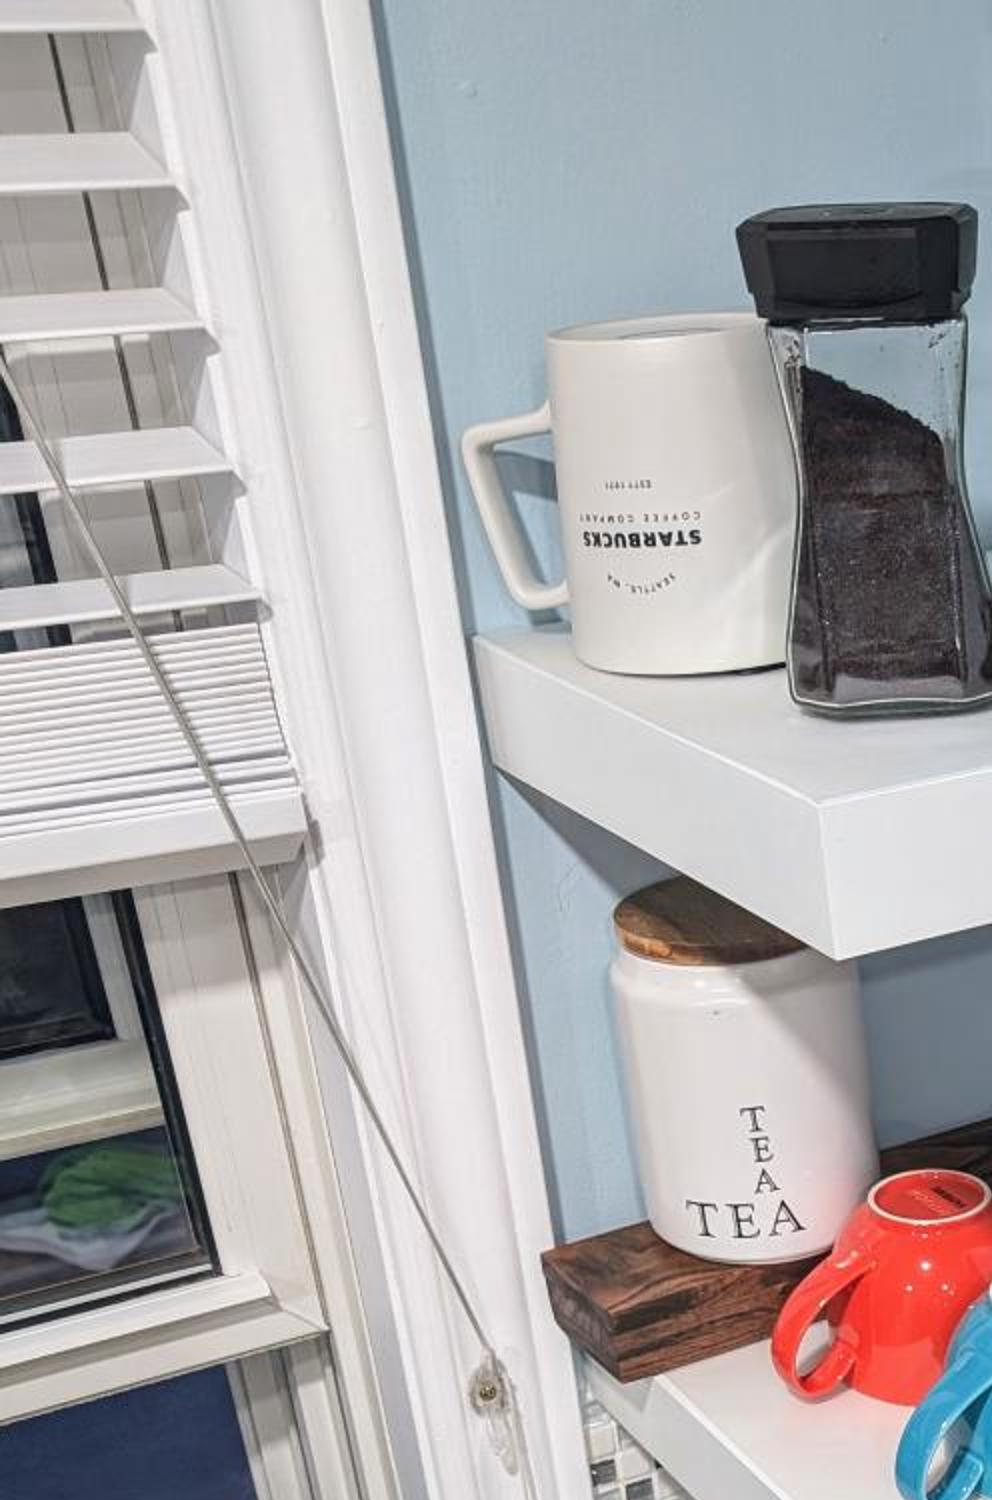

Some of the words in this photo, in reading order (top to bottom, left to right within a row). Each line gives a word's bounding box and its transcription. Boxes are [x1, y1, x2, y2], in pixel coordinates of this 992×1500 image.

[579, 513, 635, 524] COMPANY
[643, 511, 701, 523] COFFEE
[583, 529, 703, 549] STARBUCKS
[739, 1105, 782, 1195] TEA
[685, 1199, 808, 1239] TEA
